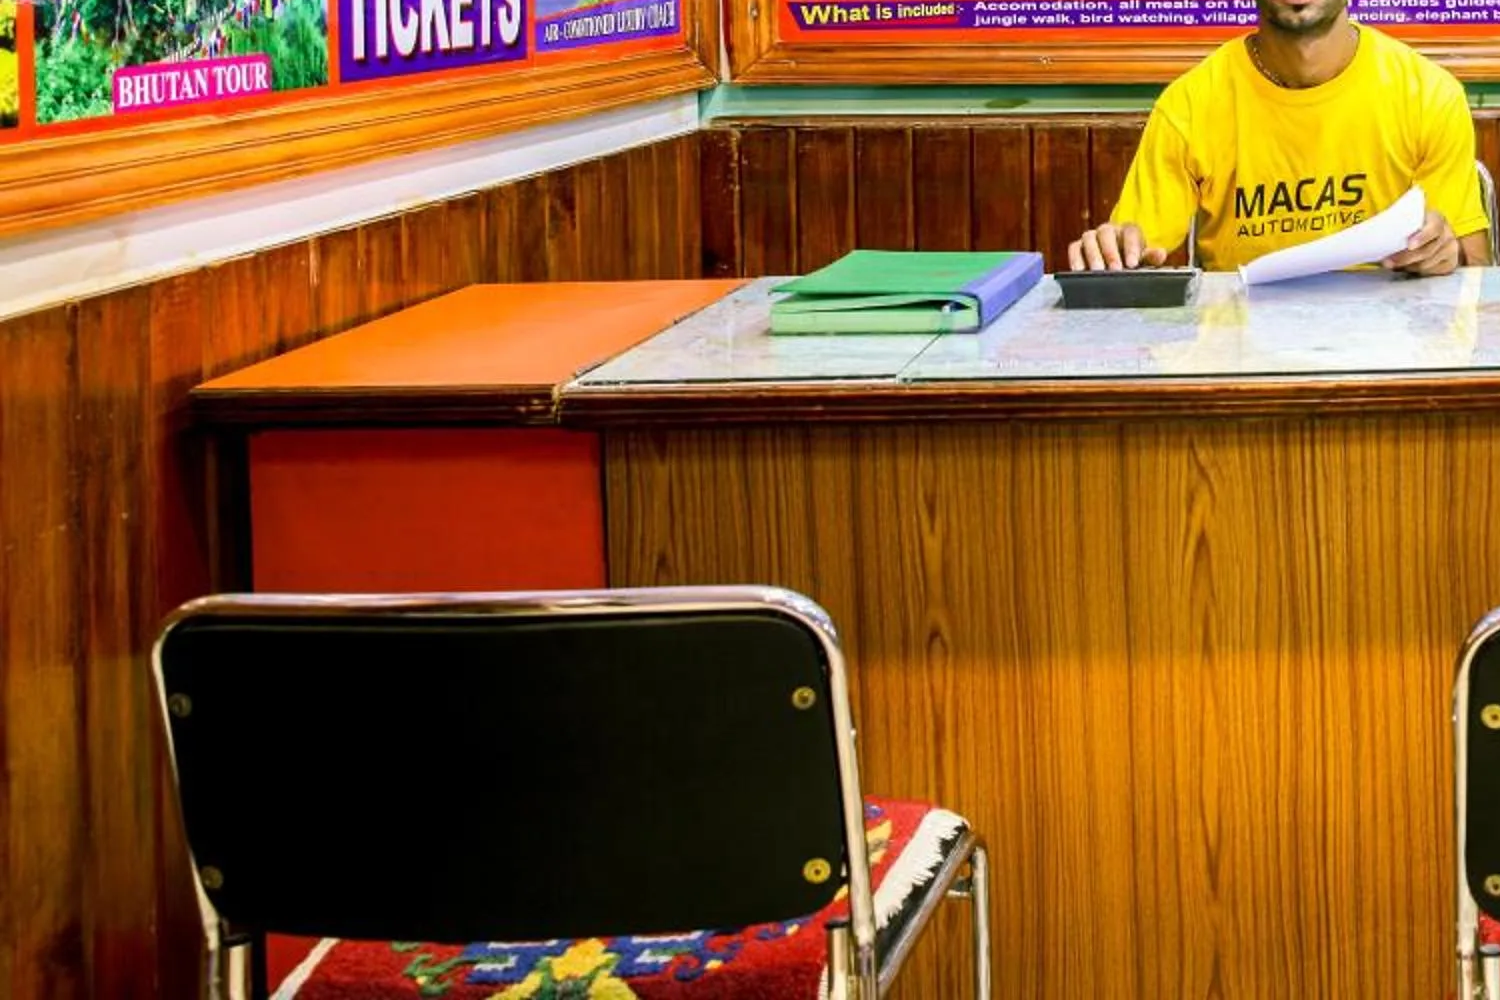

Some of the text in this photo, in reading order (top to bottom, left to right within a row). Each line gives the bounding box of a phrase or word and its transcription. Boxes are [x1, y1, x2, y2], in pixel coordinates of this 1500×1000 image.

[800, 4, 871, 25] What
[876, 4, 893, 20] is
[1119, 0, 1140, 9] all
[1145, 0, 1200, 9] meals
[1205, 1, 1228, 9] on
[1233, 0, 1257, 9] ful
[117, 62, 269, 108] BHUTAN TOUR
[1235, 173, 1367, 219] MACAS
[1237, 209, 1366, 238] AUTOMOTIVE
